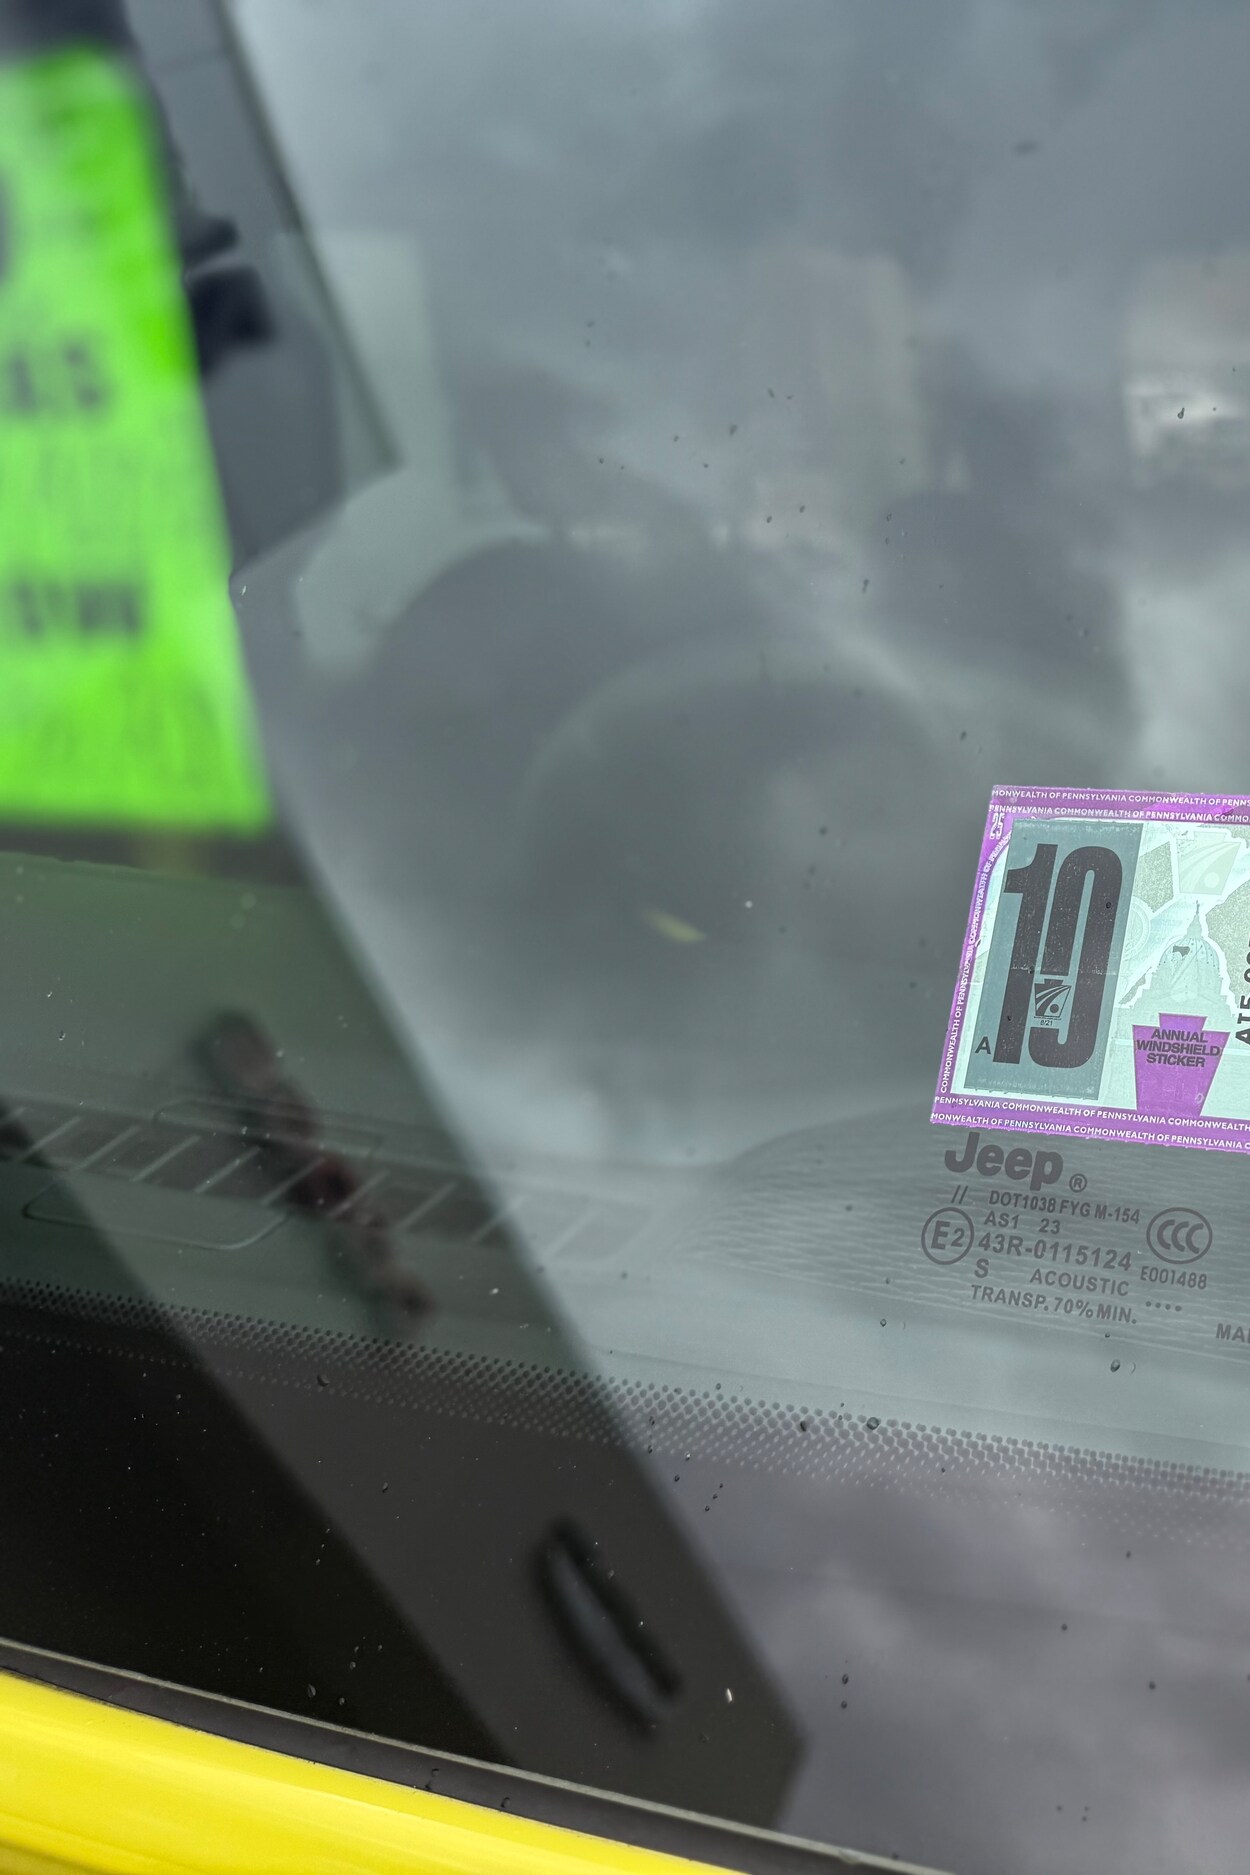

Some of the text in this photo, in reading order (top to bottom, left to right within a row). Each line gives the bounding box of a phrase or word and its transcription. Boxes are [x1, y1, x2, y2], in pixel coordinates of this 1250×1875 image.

[1050, 791, 1062, 800] OF
[1062, 792, 1128, 802] PENNSYLVANIA
[1128, 794, 1208, 805] COMMONWEALTH
[1208, 798, 1221, 806] OF
[988, 804, 1053, 815] PENNSYLVANIA
[1054, 807, 1131, 818] COMMONWEALTH
[1132, 811, 1144, 819] OF
[1146, 811, 1213, 822] PENNSYLVANIA
[990, 812, 1005, 839] 25
[992, 843, 1123, 1069] 10
[975, 1036, 992, 1055] A
[1136, 1040, 1221, 1057] WINDSHIELD
[1151, 1028, 1208, 1044] ANNUAL
[940, 1025, 960, 1094] COMMONWEALTH
[955, 1006, 963, 1019] OF
[1146, 1053, 1206, 1068] STICKER
[934, 1096, 1000, 1109] PENNSYLVANIA
[1002, 1102, 1082, 1116] COMMONWEALTH
[1083, 1109, 1096, 1117] OF
[1097, 1110, 1166, 1125] PENNSYLVANIA
[990, 1118, 1003, 1126] OF
[1004, 1118, 1072, 1132] PENNSYLVANIA
[1073, 1125, 1156, 1141] COMMONWEALTH
[1156, 1133, 1170, 1142] OF
[1170, 1135, 1242, 1149] PENNSYLVANIA
[944, 1131, 1064, 1191] Jeep
[989, 1190, 1056, 1213] DOT1038
[1059, 1202, 1091, 1218] FYG
[1094, 1204, 1140, 1225] M-154
[984, 1210, 1062, 1235] AS1 23
[978, 1232, 1132, 1272] 43R-0115124
[974, 1258, 1130, 1297] S ACOUSTIC
[1140, 1266, 1208, 1290] E001488
